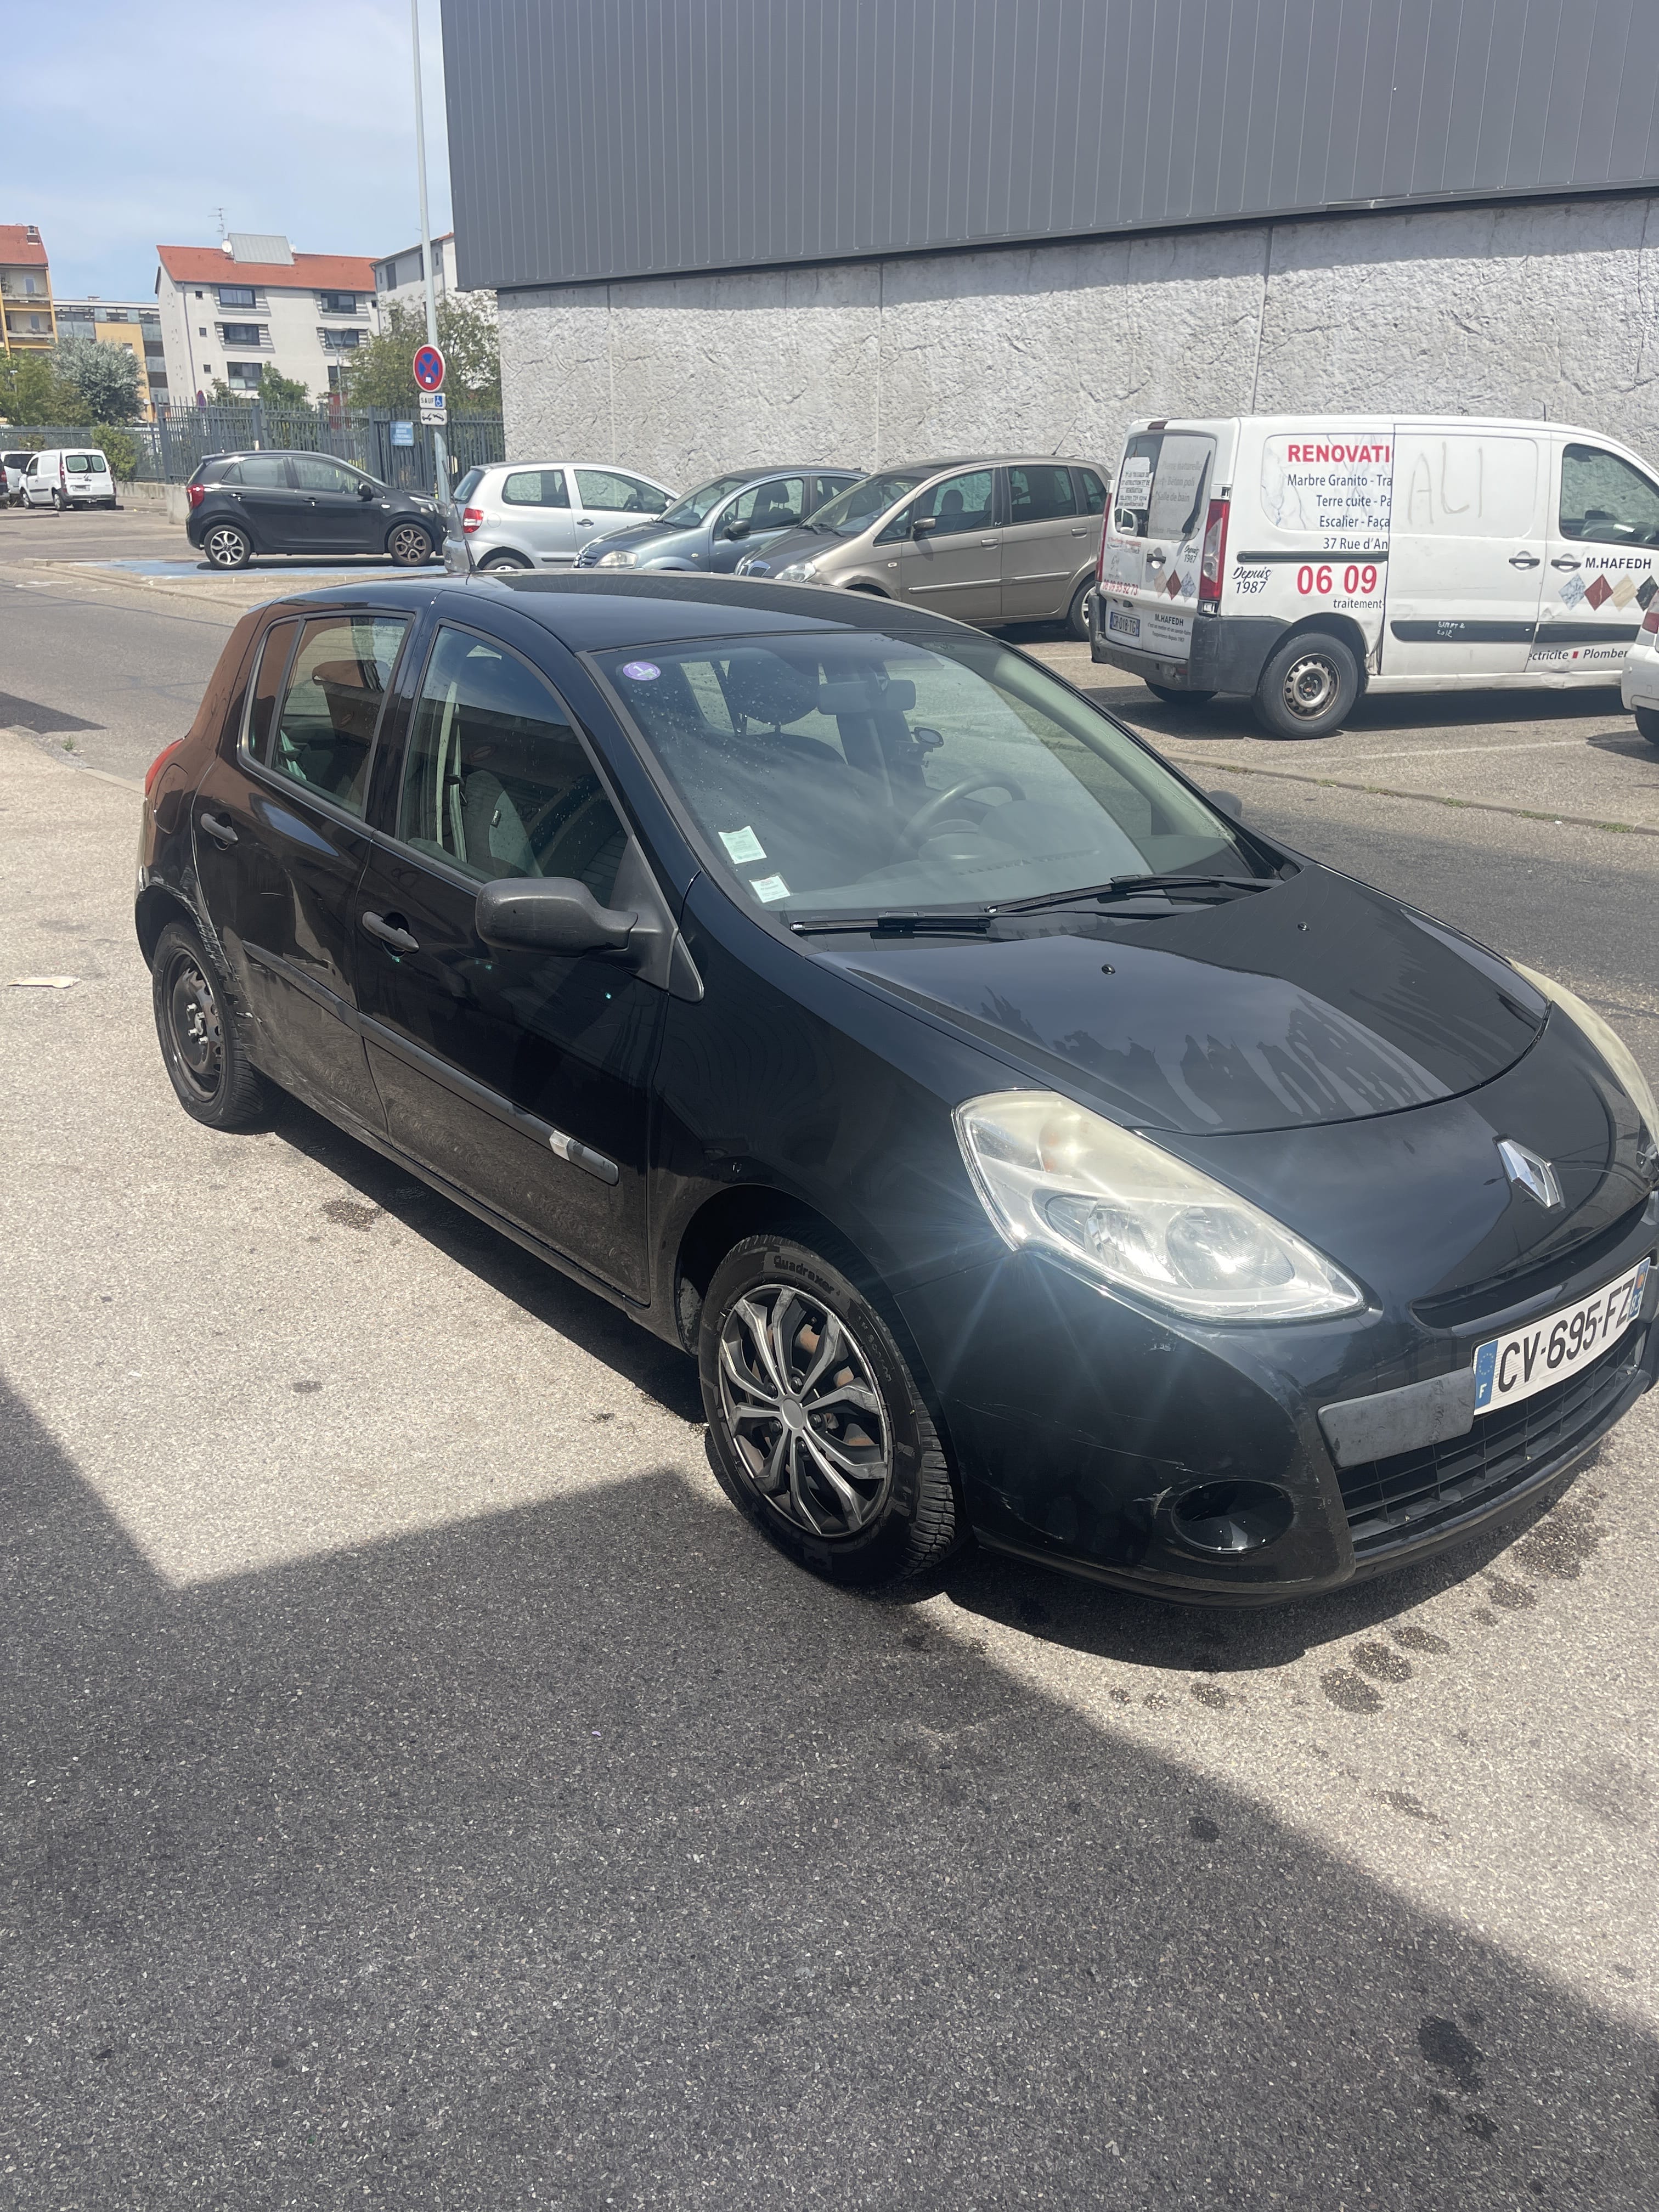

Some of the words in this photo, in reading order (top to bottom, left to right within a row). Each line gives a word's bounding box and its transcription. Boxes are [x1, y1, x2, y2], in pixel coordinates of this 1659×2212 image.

[1288, 444, 1393, 462] RENOVATI
[1184, 477, 1194, 489] poli
[1288, 473, 1325, 486] Marbre
[1329, 474, 1368, 486] Granito
[1170, 493, 1177, 501] de
[1178, 493, 1190, 502] bain
[1316, 495, 1343, 507] Terre
[1346, 495, 1371, 507] cuite
[1319, 515, 1359, 527] Escalier
[1323, 538, 1337, 549] 37
[1340, 538, 1361, 549] Rue
[1184, 554, 1197, 563] 1987
[1585, 557, 1651, 569] M.HAFEDH
[1232, 567, 1272, 584] Depuis
[1297, 565, 1333, 595] 06
[1344, 565, 1377, 594] 09
[1131, 584, 1139, 595] 73
[1235, 581, 1266, 594] 1987
[1113, 615, 1136, 633] CR-018-TG
[1155, 613, 1184, 626] M.HAFEDH
[1479, 1383, 1487, 1398] F
[1498, 1277, 1635, 1393] CV-695-FZ
[1629, 1290, 1643, 1314] 83
